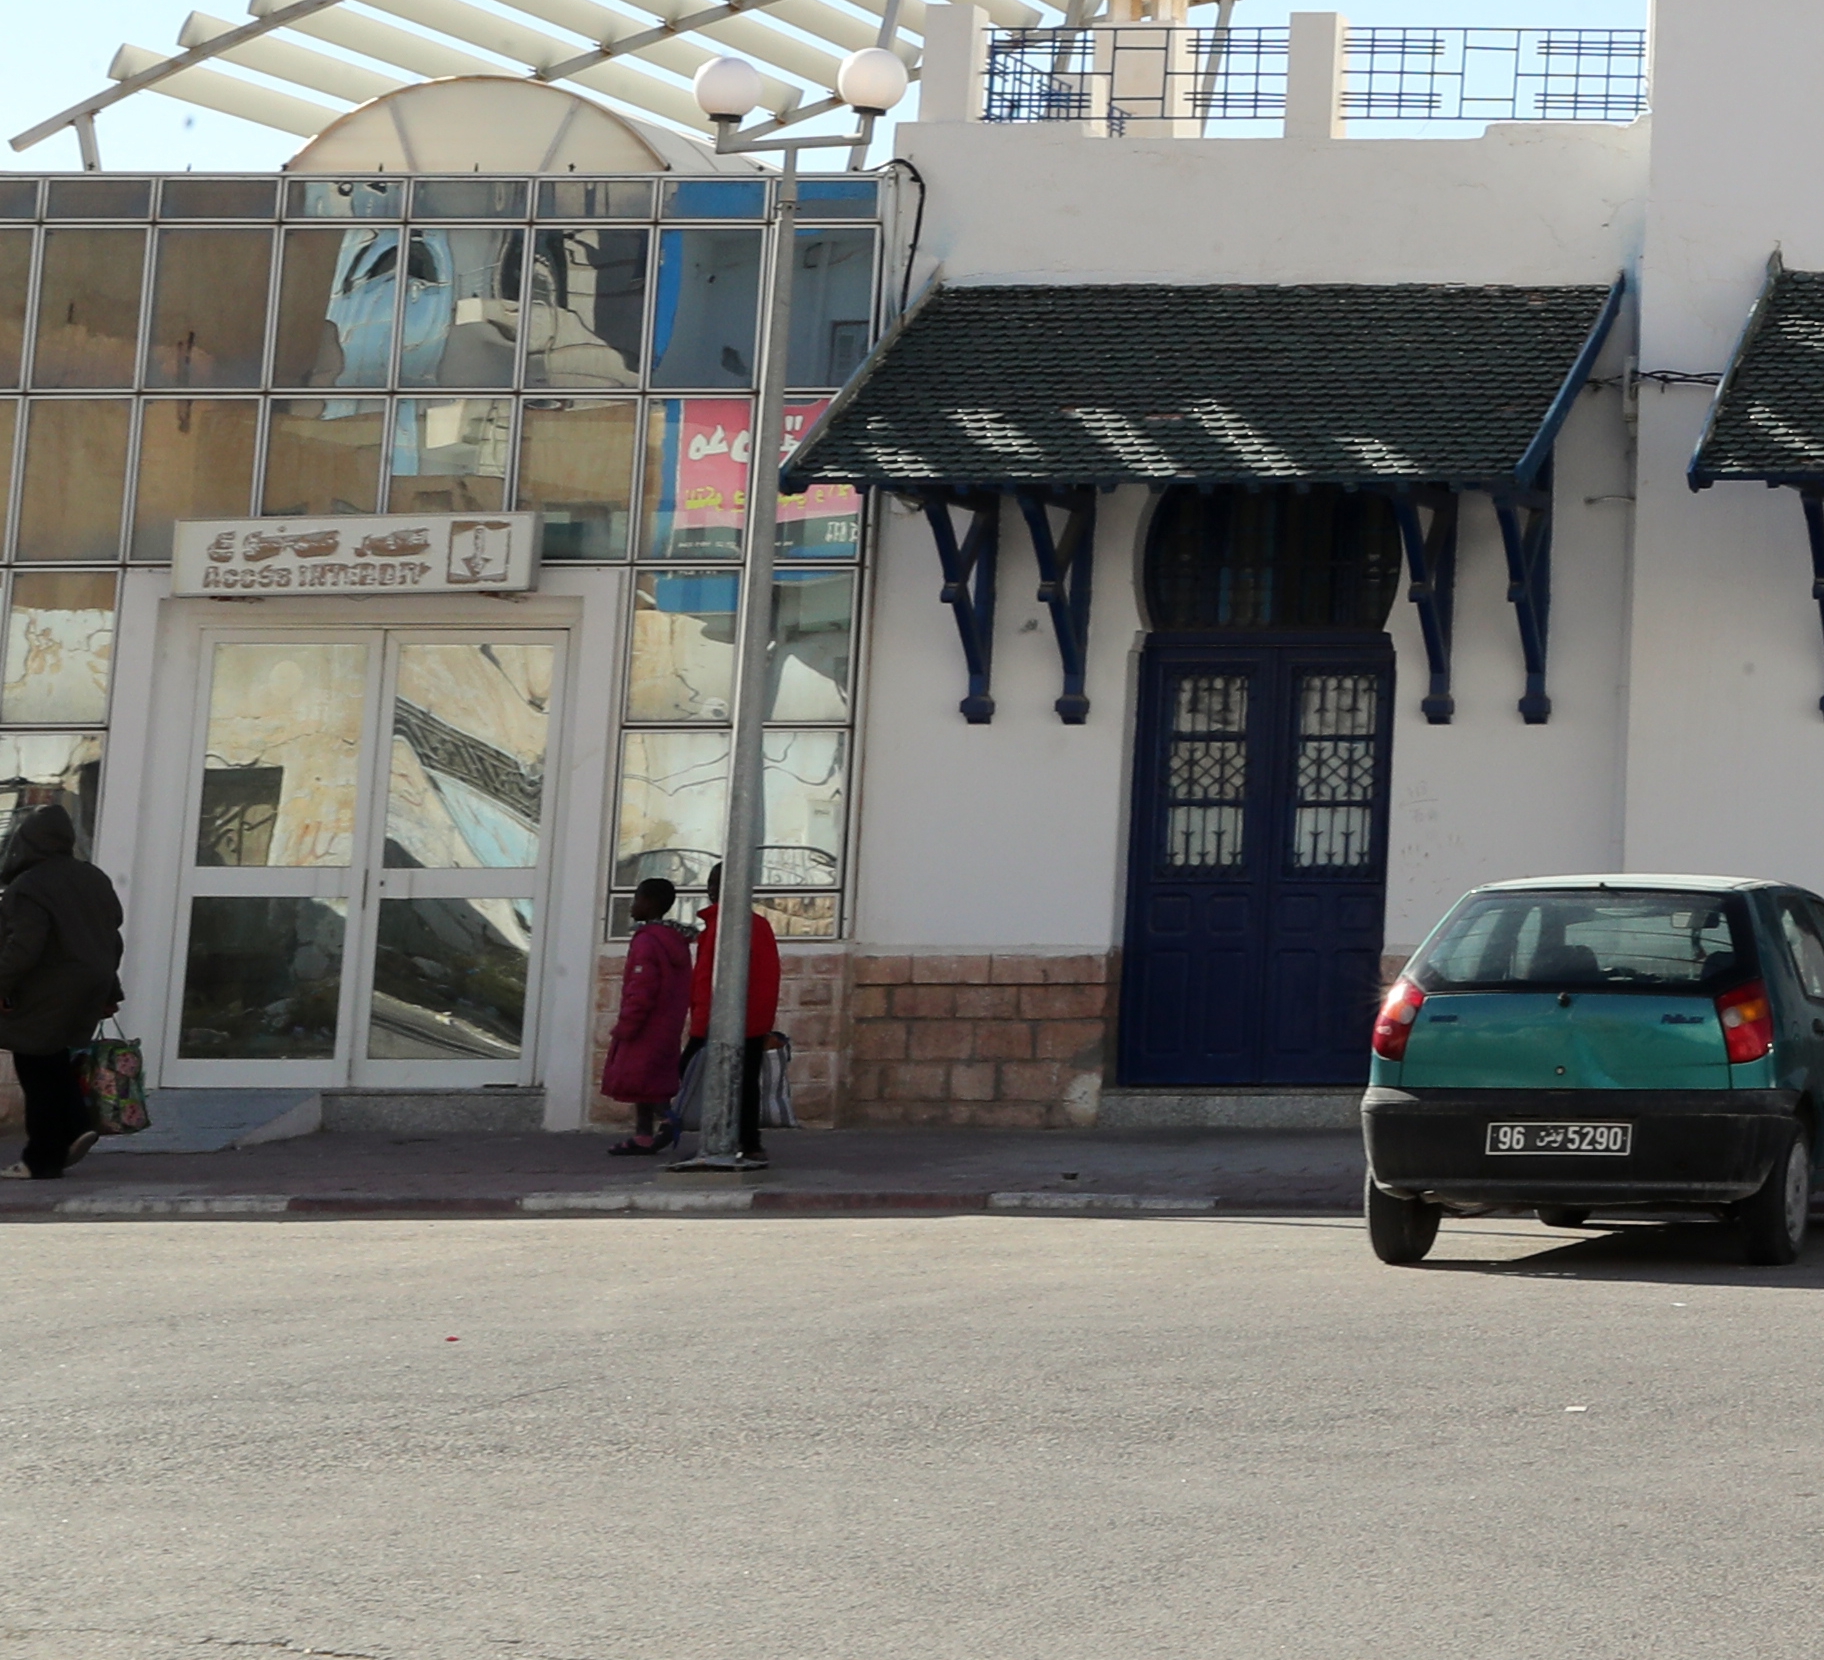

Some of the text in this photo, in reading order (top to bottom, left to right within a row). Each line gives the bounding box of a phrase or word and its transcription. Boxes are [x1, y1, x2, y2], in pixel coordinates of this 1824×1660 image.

[1498, 1126, 1623, 1151] 96 تونس 5290
